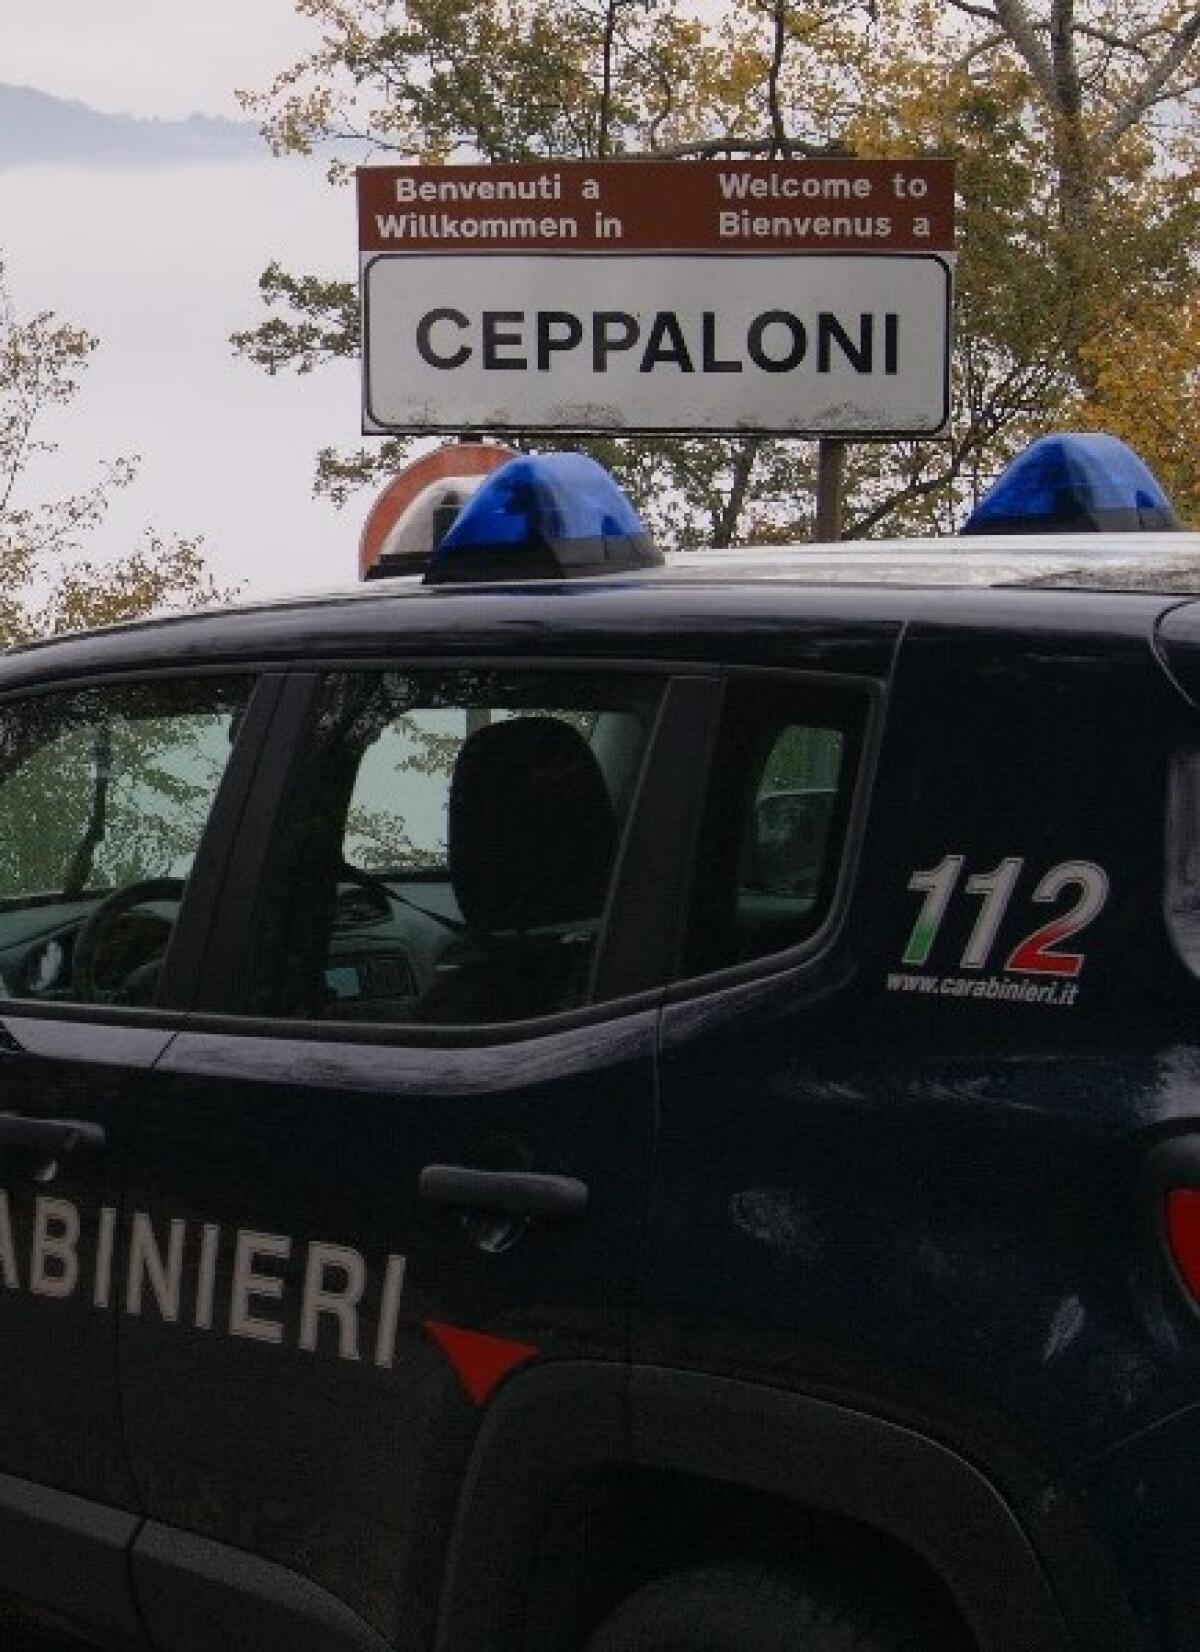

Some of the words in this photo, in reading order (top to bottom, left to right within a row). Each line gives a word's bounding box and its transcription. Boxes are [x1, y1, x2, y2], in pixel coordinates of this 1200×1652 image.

[395, 173, 561, 202] Benvenuti
[581, 178, 600, 200] a
[718, 173, 872, 199] Welcome
[891, 173, 928, 198] to
[375, 212, 578, 238] Willkommen
[594, 211, 623, 238] in
[719, 209, 892, 238] Bienvenus
[912, 217, 931, 237] a
[415, 307, 899, 375] CEPPALONI
[901, 854, 1110, 977] 112
[887, 973, 1079, 1005] www.carabinieri.it
